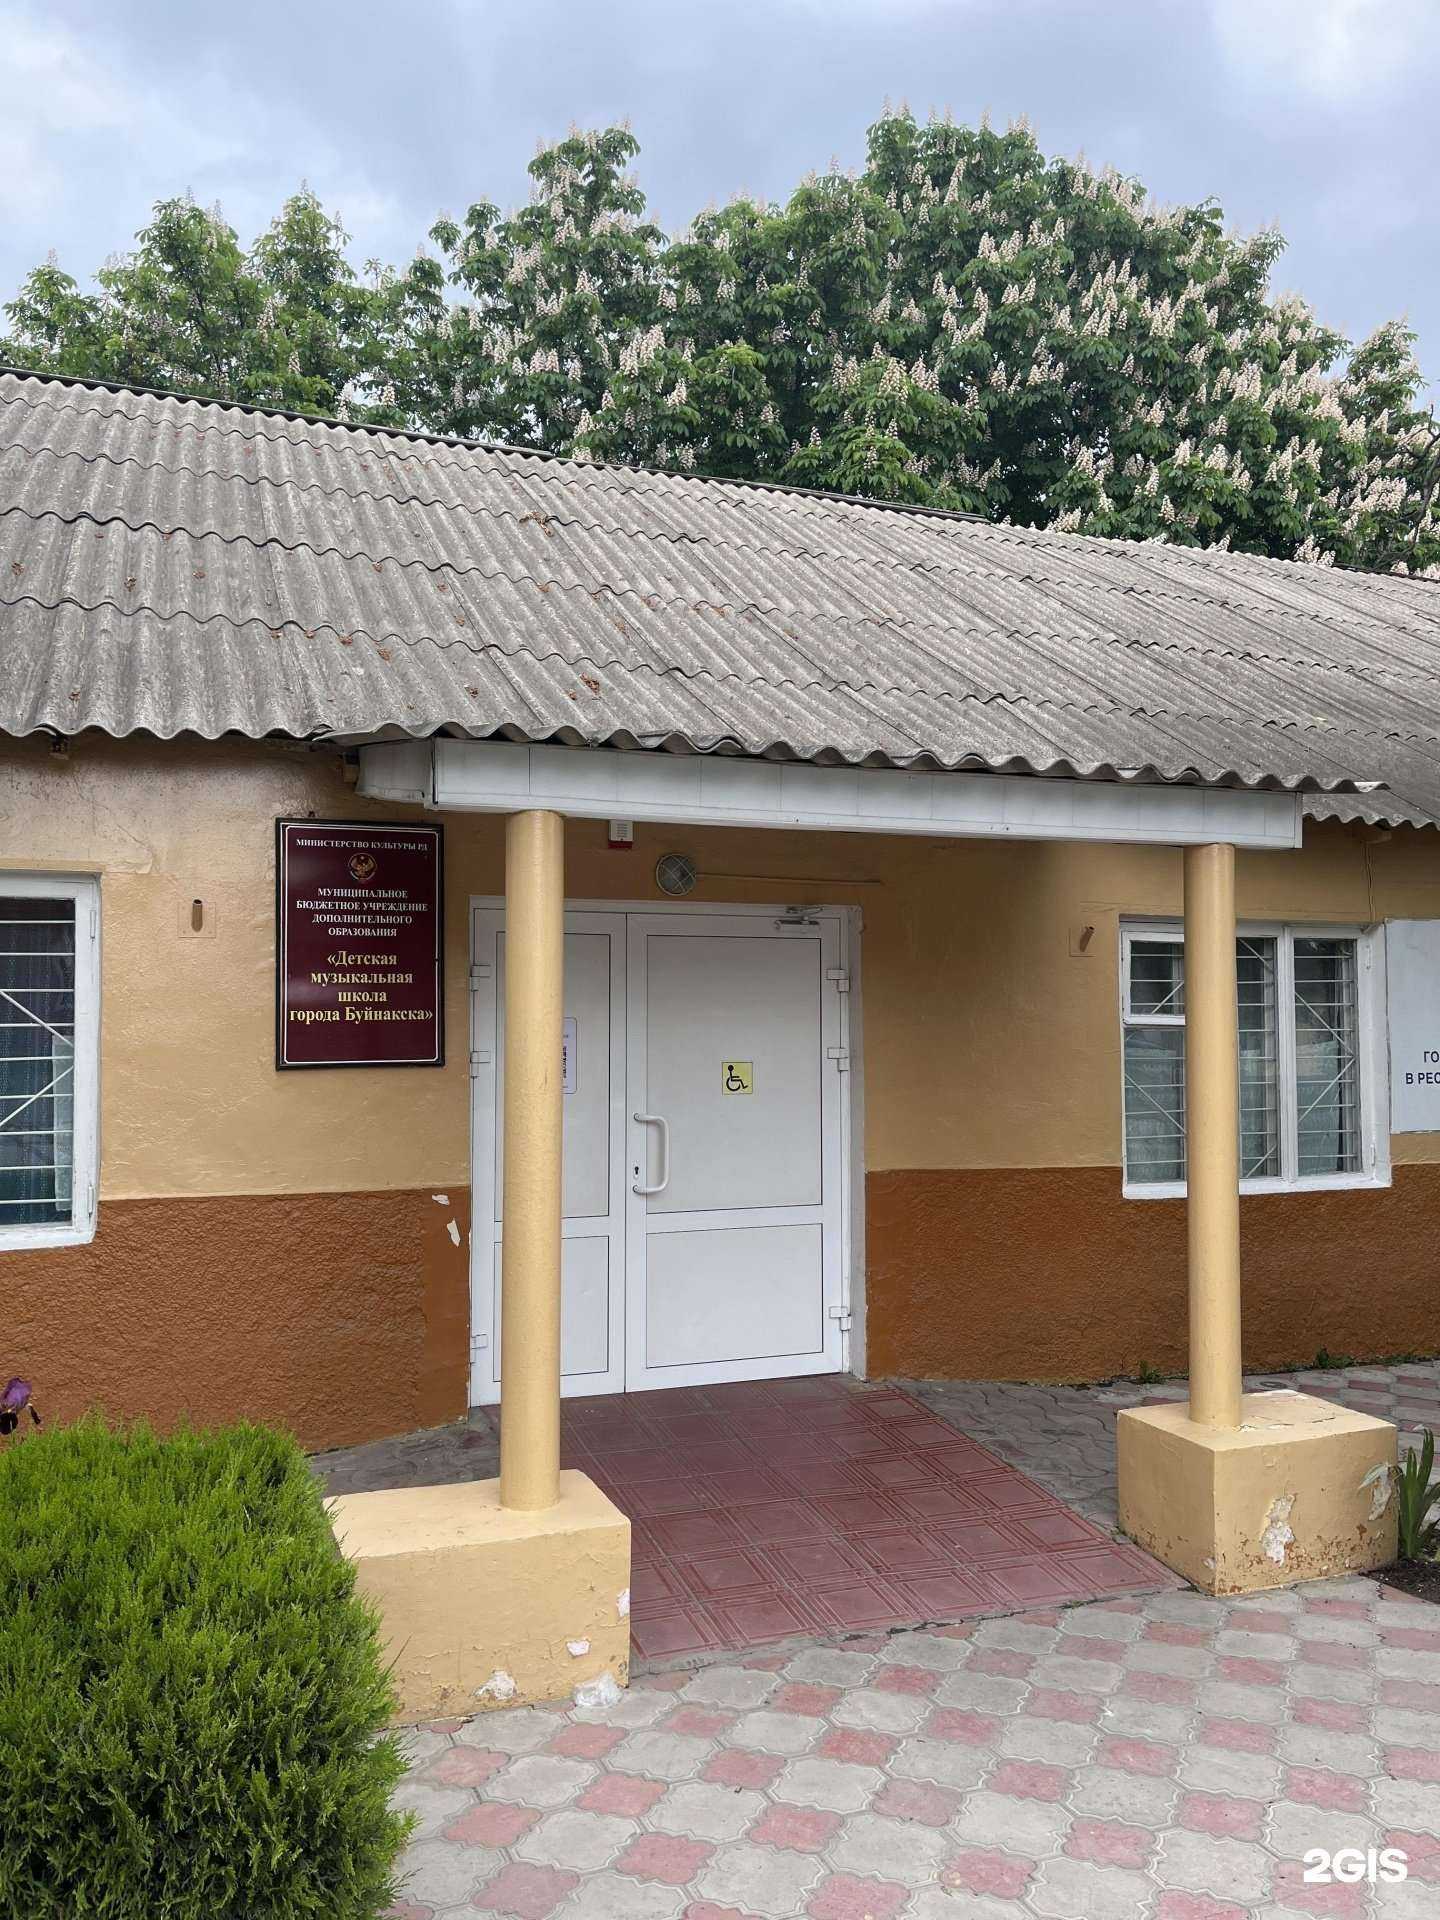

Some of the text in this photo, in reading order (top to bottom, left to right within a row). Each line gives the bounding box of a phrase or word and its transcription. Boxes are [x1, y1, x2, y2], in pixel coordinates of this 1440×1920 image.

[296, 838, 428, 851] МИНИСТЕРСТВО КУЛЬТУРЫ РД
[317, 887, 408, 900] МУНИЦИПАЛЬНОЕ
[296, 900, 428, 912] БЮДЖЕТНОЕ УЧРЕЖДЕНИЕ
[312, 913, 412, 925] ДОПОЛНИТЕЛЬНОГО
[328, 927, 397, 937] ОБРАЗОВАНИЯ
[327, 951, 397, 967] «Детская
[311, 971, 413, 987] музыкальная
[338, 990, 387, 1002] школа
[290, 1007, 433, 1025] города Буйнакска»
[1406, 1073, 1414, 1084] В
